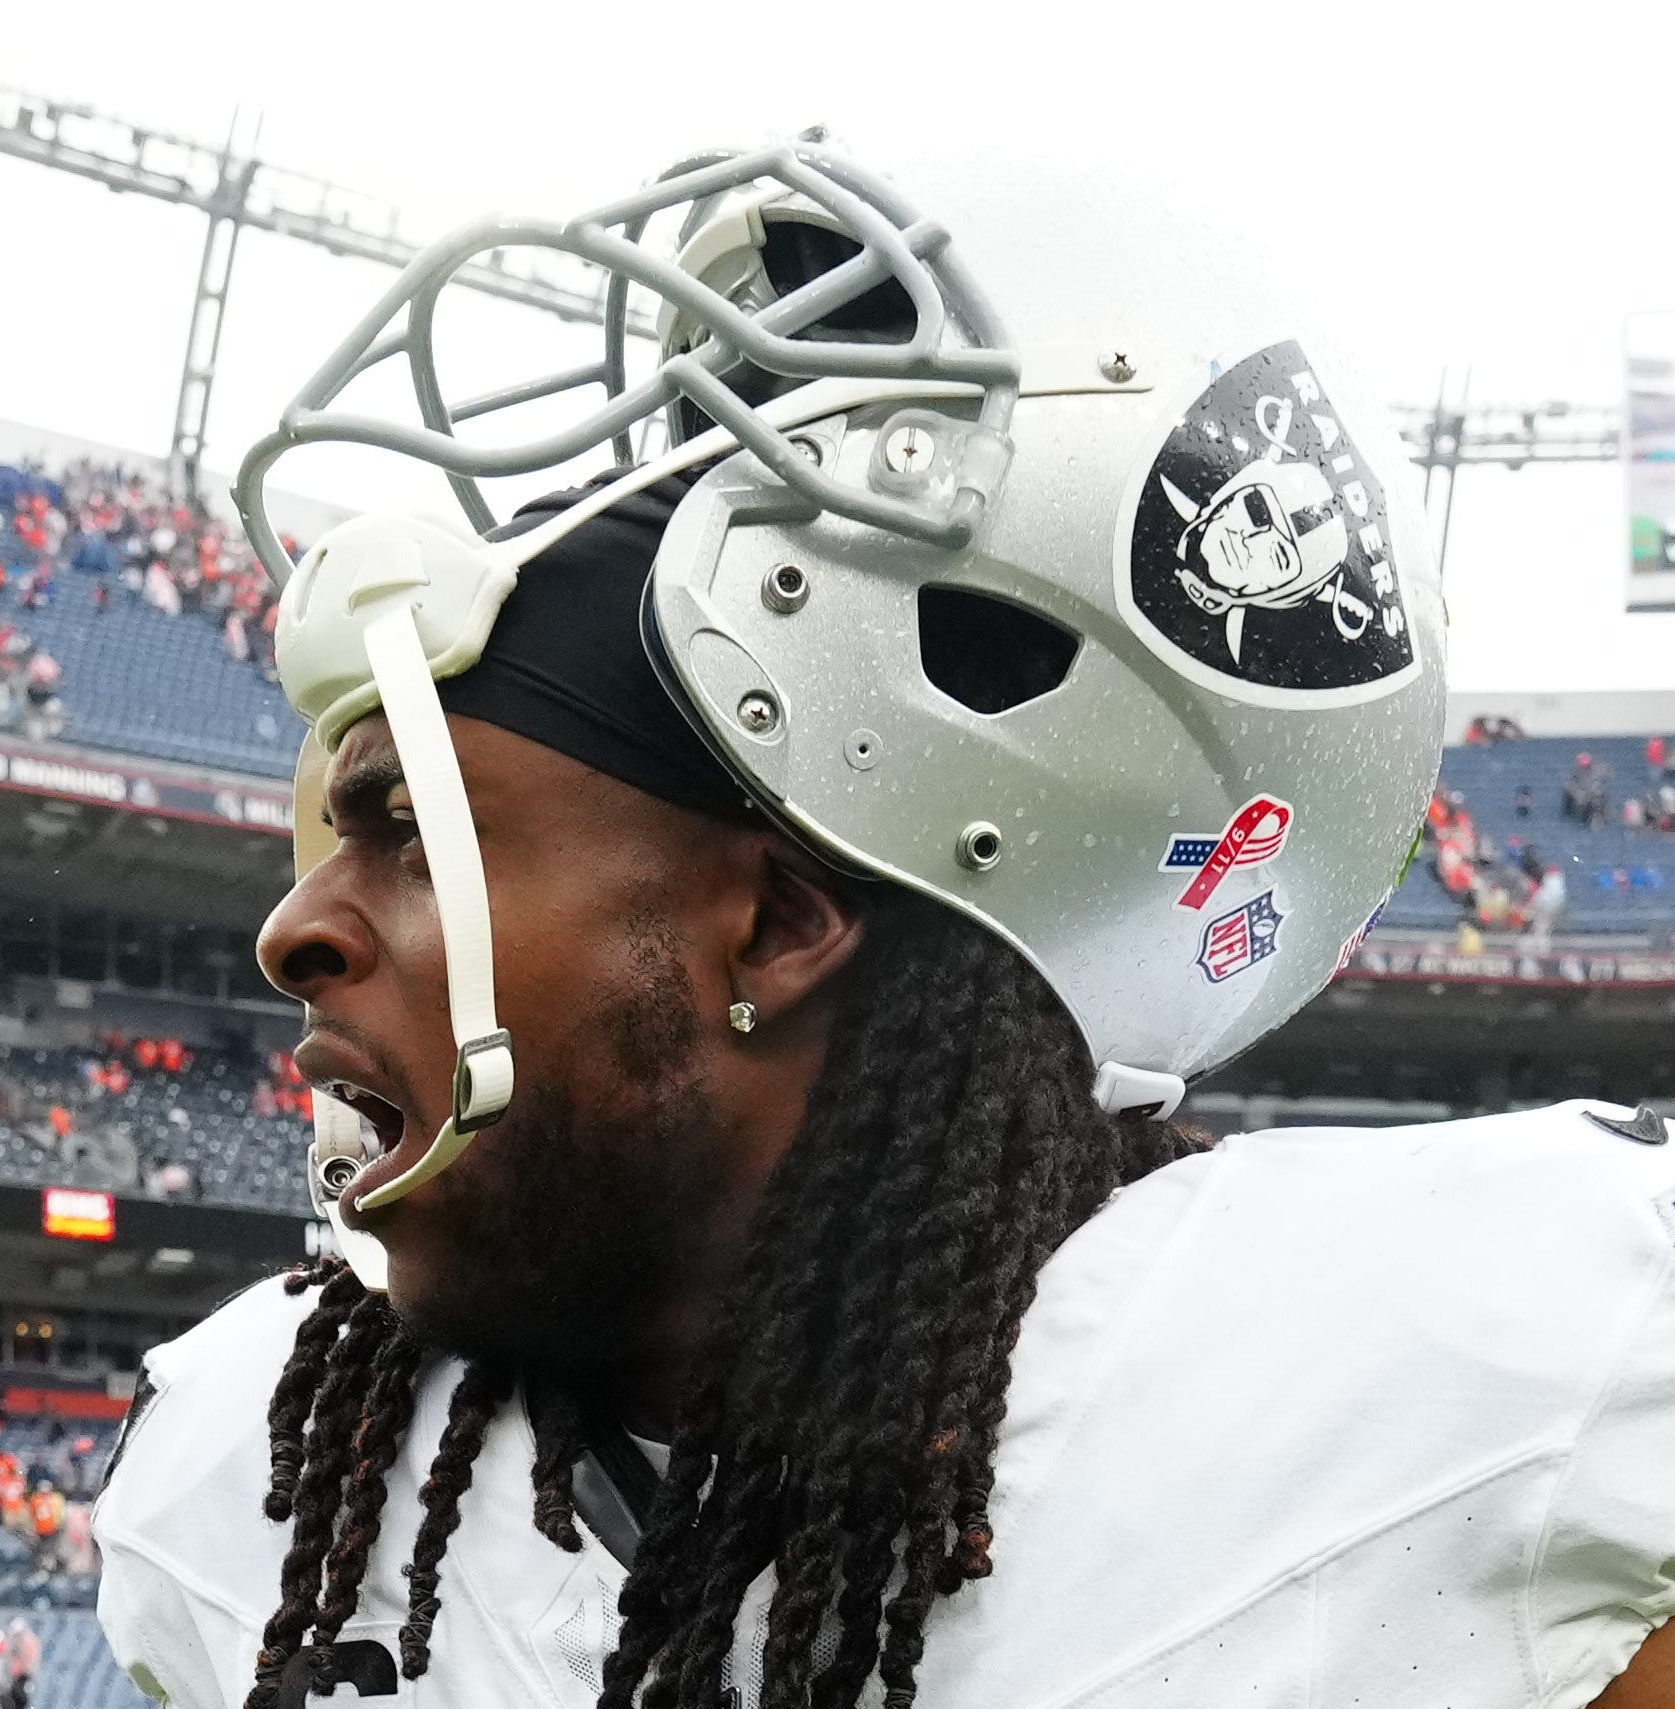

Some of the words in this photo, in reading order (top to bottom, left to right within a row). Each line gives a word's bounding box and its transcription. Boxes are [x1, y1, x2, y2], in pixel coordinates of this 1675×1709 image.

[1290, 370, 1405, 638] RAIDERS
[1210, 827, 1246, 874] 9/11
[1207, 912, 1249, 979] NFL
